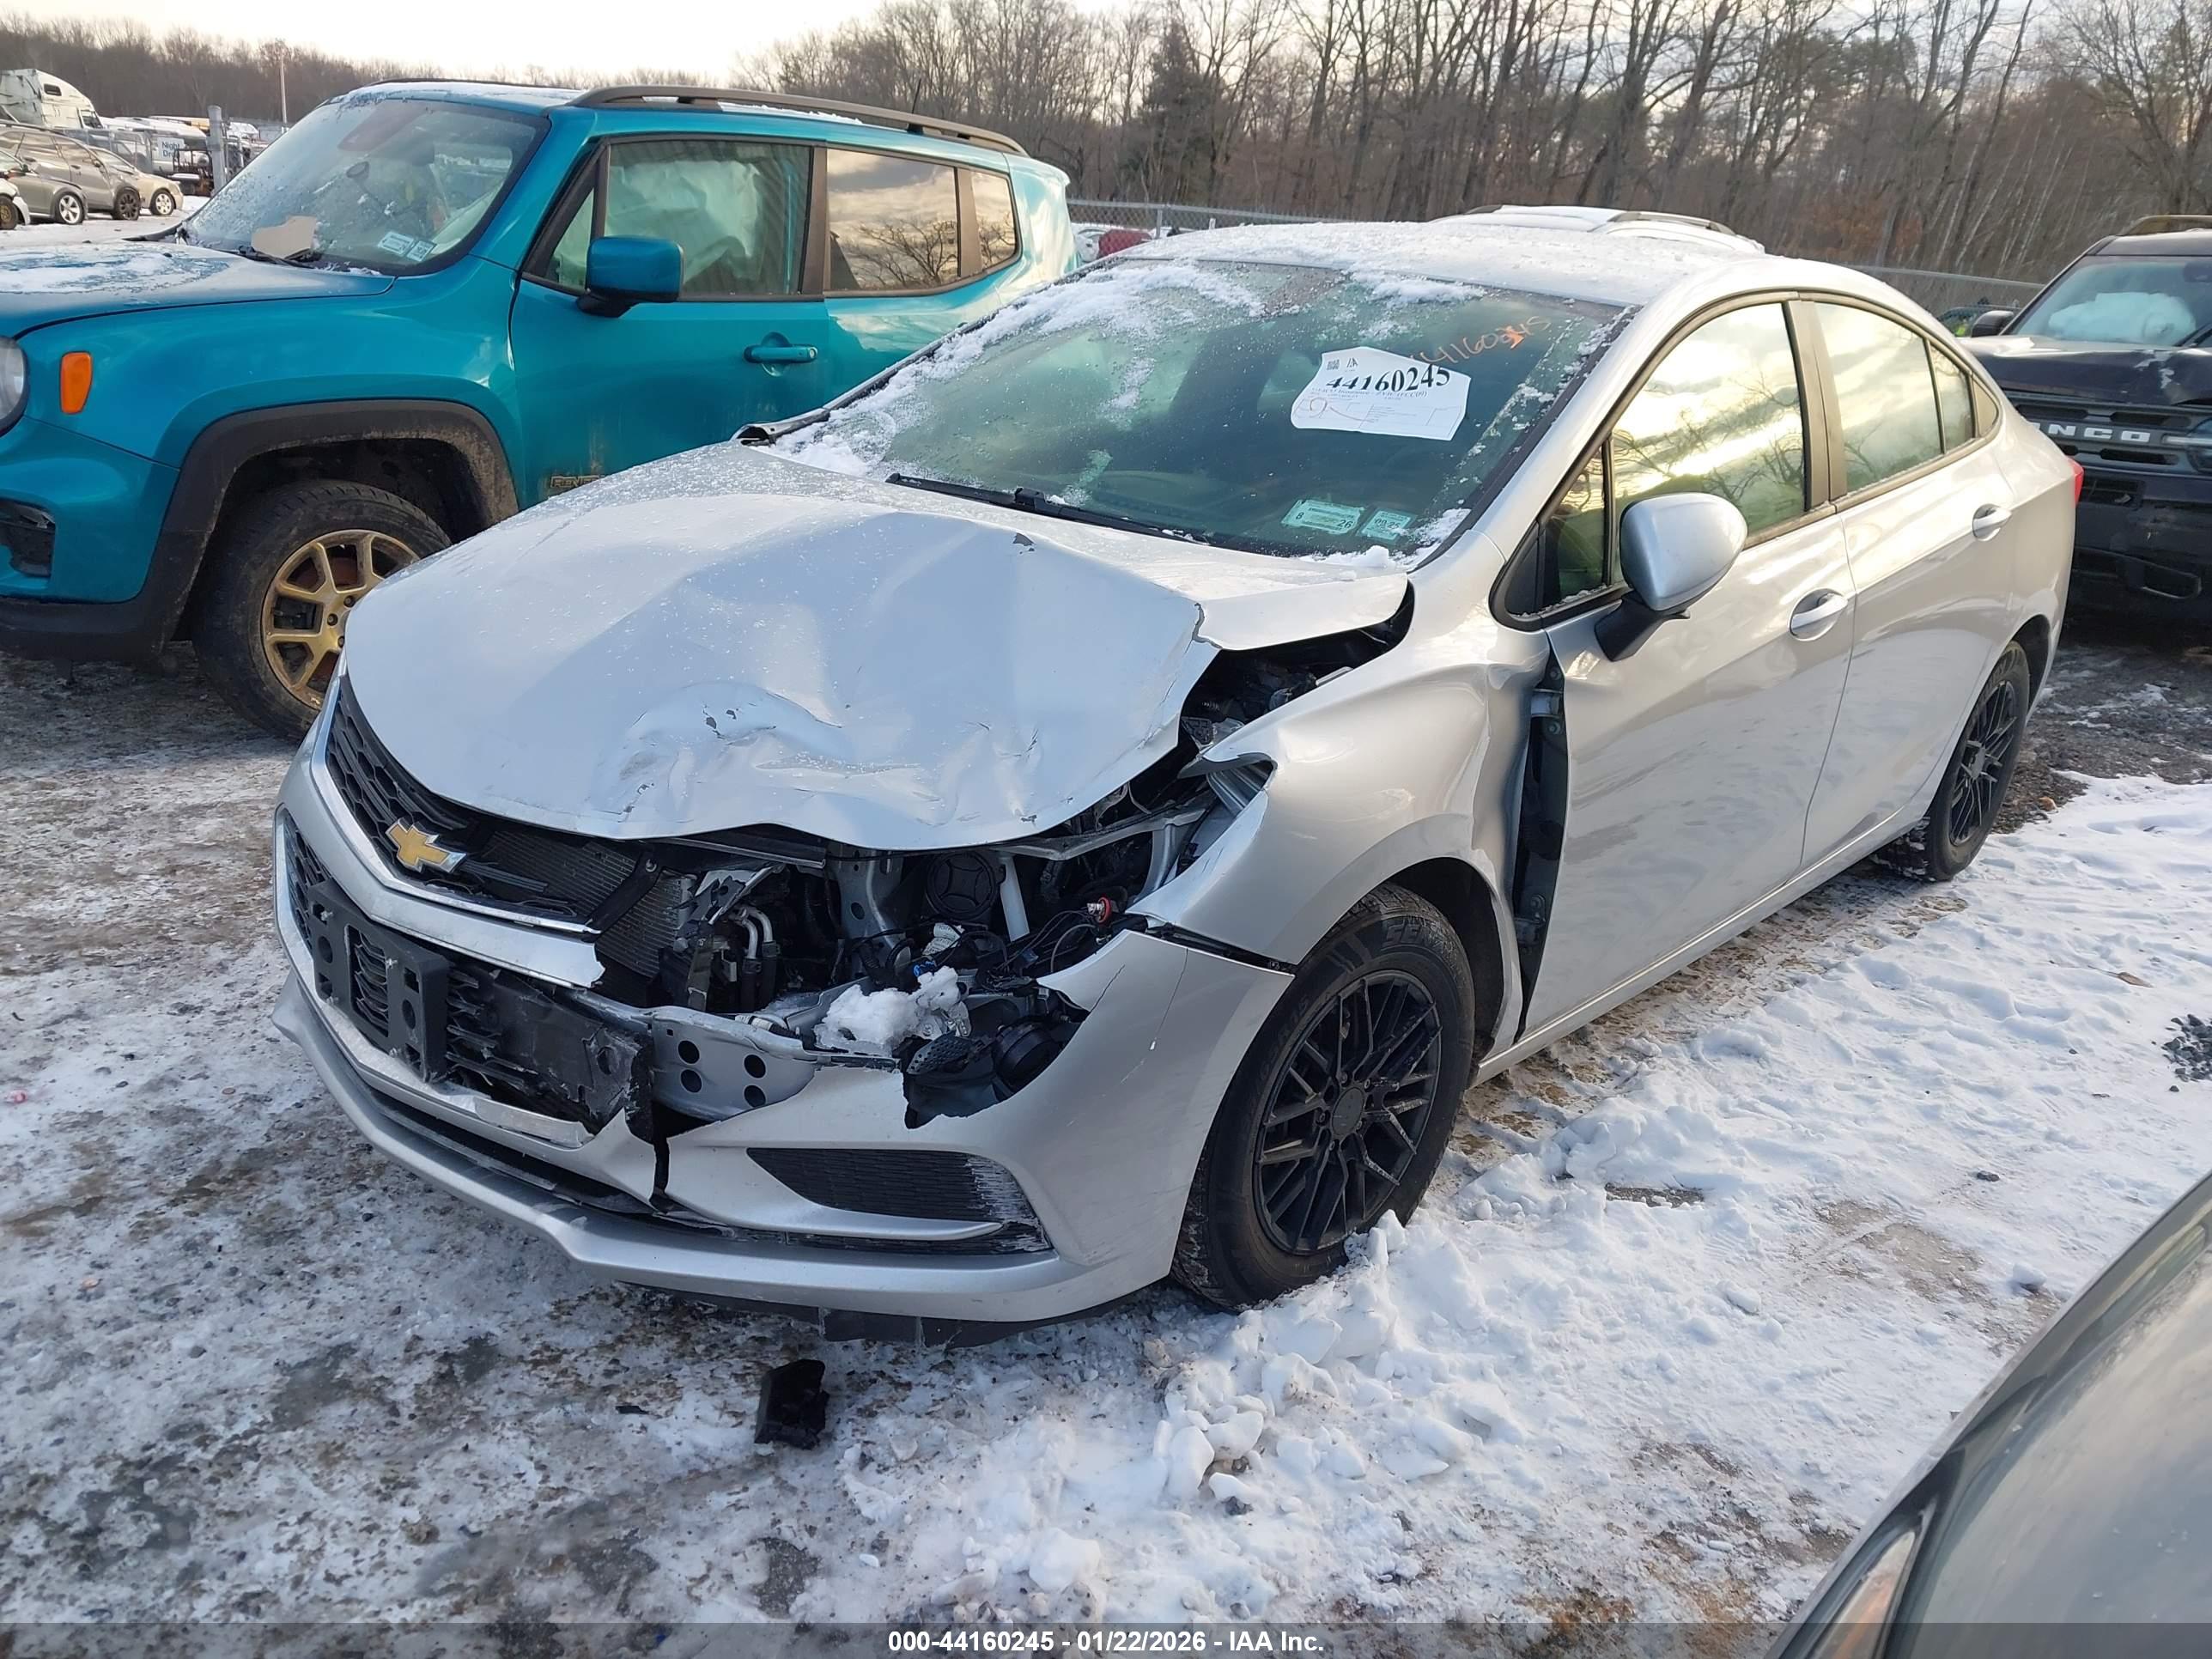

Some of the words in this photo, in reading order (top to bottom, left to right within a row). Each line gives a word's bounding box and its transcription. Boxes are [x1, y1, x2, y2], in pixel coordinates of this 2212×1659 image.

[161, 141, 180, 151] Night
[1326, 363, 1450, 392] 44160245
[1296, 512, 1304, 520] 8
[1337, 519, 1354, 529] 26
